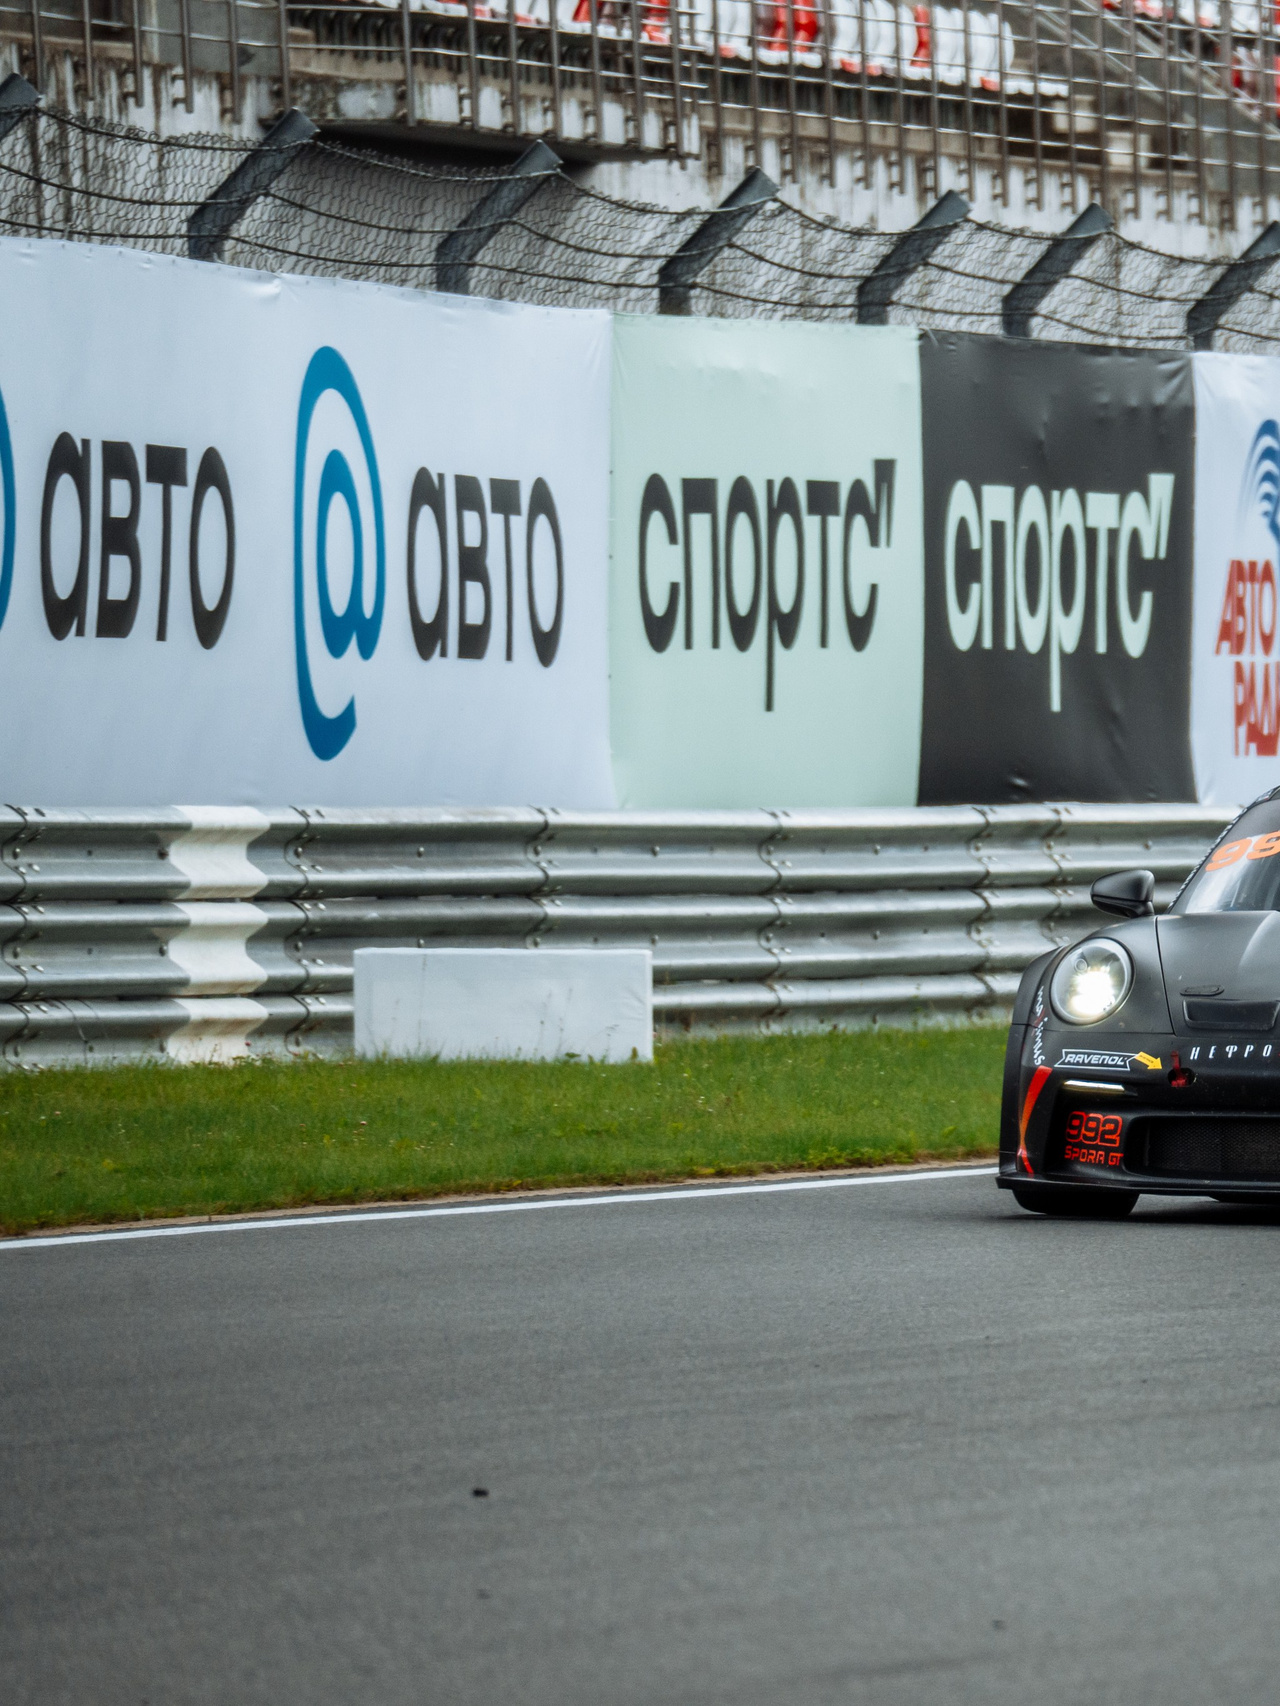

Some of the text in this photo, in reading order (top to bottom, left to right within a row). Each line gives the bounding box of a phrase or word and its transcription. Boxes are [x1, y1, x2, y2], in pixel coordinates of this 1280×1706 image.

[40, 431, 235, 650] авто
[407, 466, 563, 668] авто
[1215, 559, 1277, 656] АВТО
[1065, 1054, 1127, 1065] RAVENOL
[1190, 1044, 1272, 1060] НЕФРО
[1066, 1111, 1122, 1147] 992
[1064, 1145, 1124, 1166] SPORA GT
